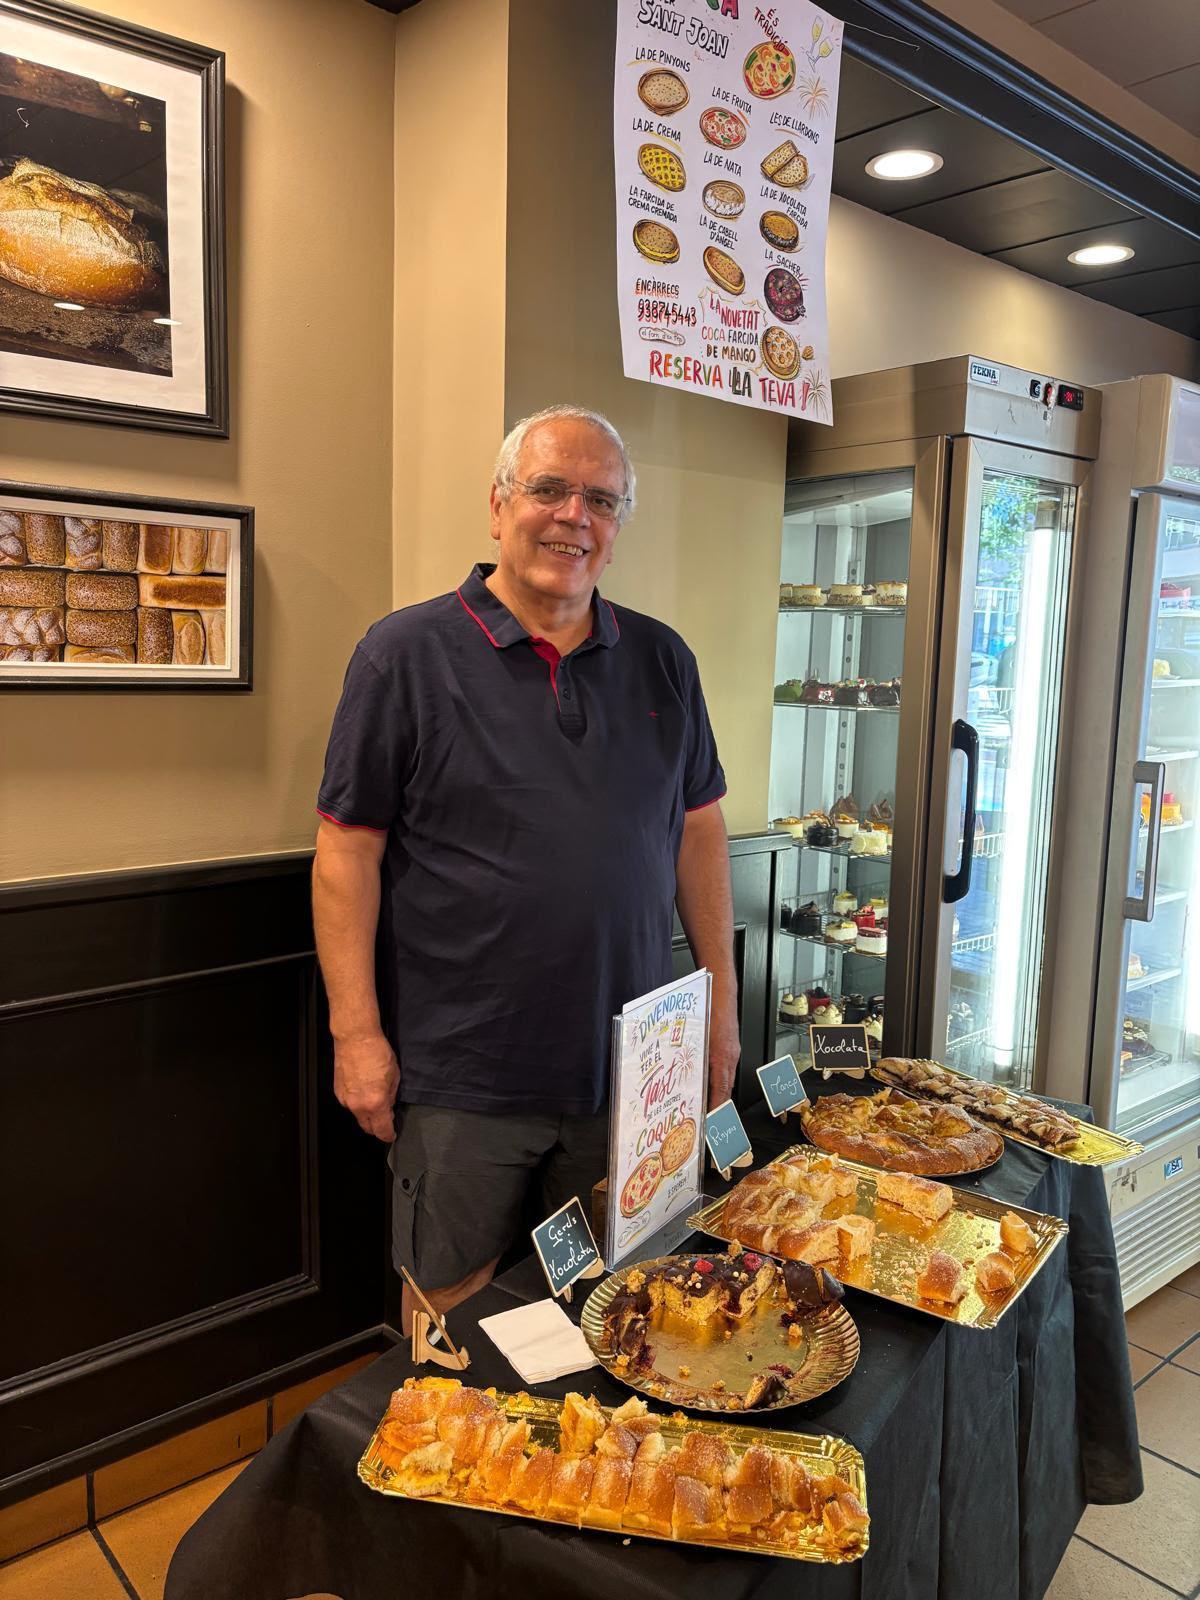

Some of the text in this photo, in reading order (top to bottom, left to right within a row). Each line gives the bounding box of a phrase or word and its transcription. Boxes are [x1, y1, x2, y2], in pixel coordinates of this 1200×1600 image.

[638, 0, 685, 36] SANT
[686, 17, 729, 58] JOAN
[755, 7, 788, 52] TRADICIÓ
[767, 8, 779, 27] ÉS
[635, 47, 691, 72] LA DE PINYONS
[712, 86, 752, 115] LA DE FRUITA
[632, 118, 681, 141] LA DE CREMA
[769, 112, 820, 144] LES DE LLARDONS
[703, 151, 742, 177] LA DE NATA
[628, 197, 678, 223] CREMA CREMADA
[629, 185, 675, 212] LA FARCIDA DE
[760, 185, 807, 216] LA DE XOCOLATA
[699, 214, 738, 242] LA DE CABELL
[786, 207, 808, 229] FARCIDA
[764, 249, 801, 277] LA SACHER
[635, 276, 680, 297] ENCÀRRECS
[638, 299, 697, 327] 938745443
[710, 293, 720, 315] LA
[720, 306, 760, 330] NOVETAT
[701, 326, 759, 346] COCA FARCIDA
[706, 344, 756, 363] DE MANGO
[650, 350, 723, 389] RESERVA
[973, 365, 996, 379] TEKNA
[639, 993, 694, 1043] DIVENDRES
[655, 1039, 660, 1051] A
[671, 1027, 681, 1042] 12
[815, 1034, 868, 1054] Xocolata
[640, 1051, 661, 1074] FER EL
[640, 1057, 678, 1118] Tast
[636, 1101, 687, 1157] COQUES
[548, 1213, 577, 1248] Gerds
[567, 1233, 573, 1245] i
[549, 1241, 595, 1280] Xocolata
